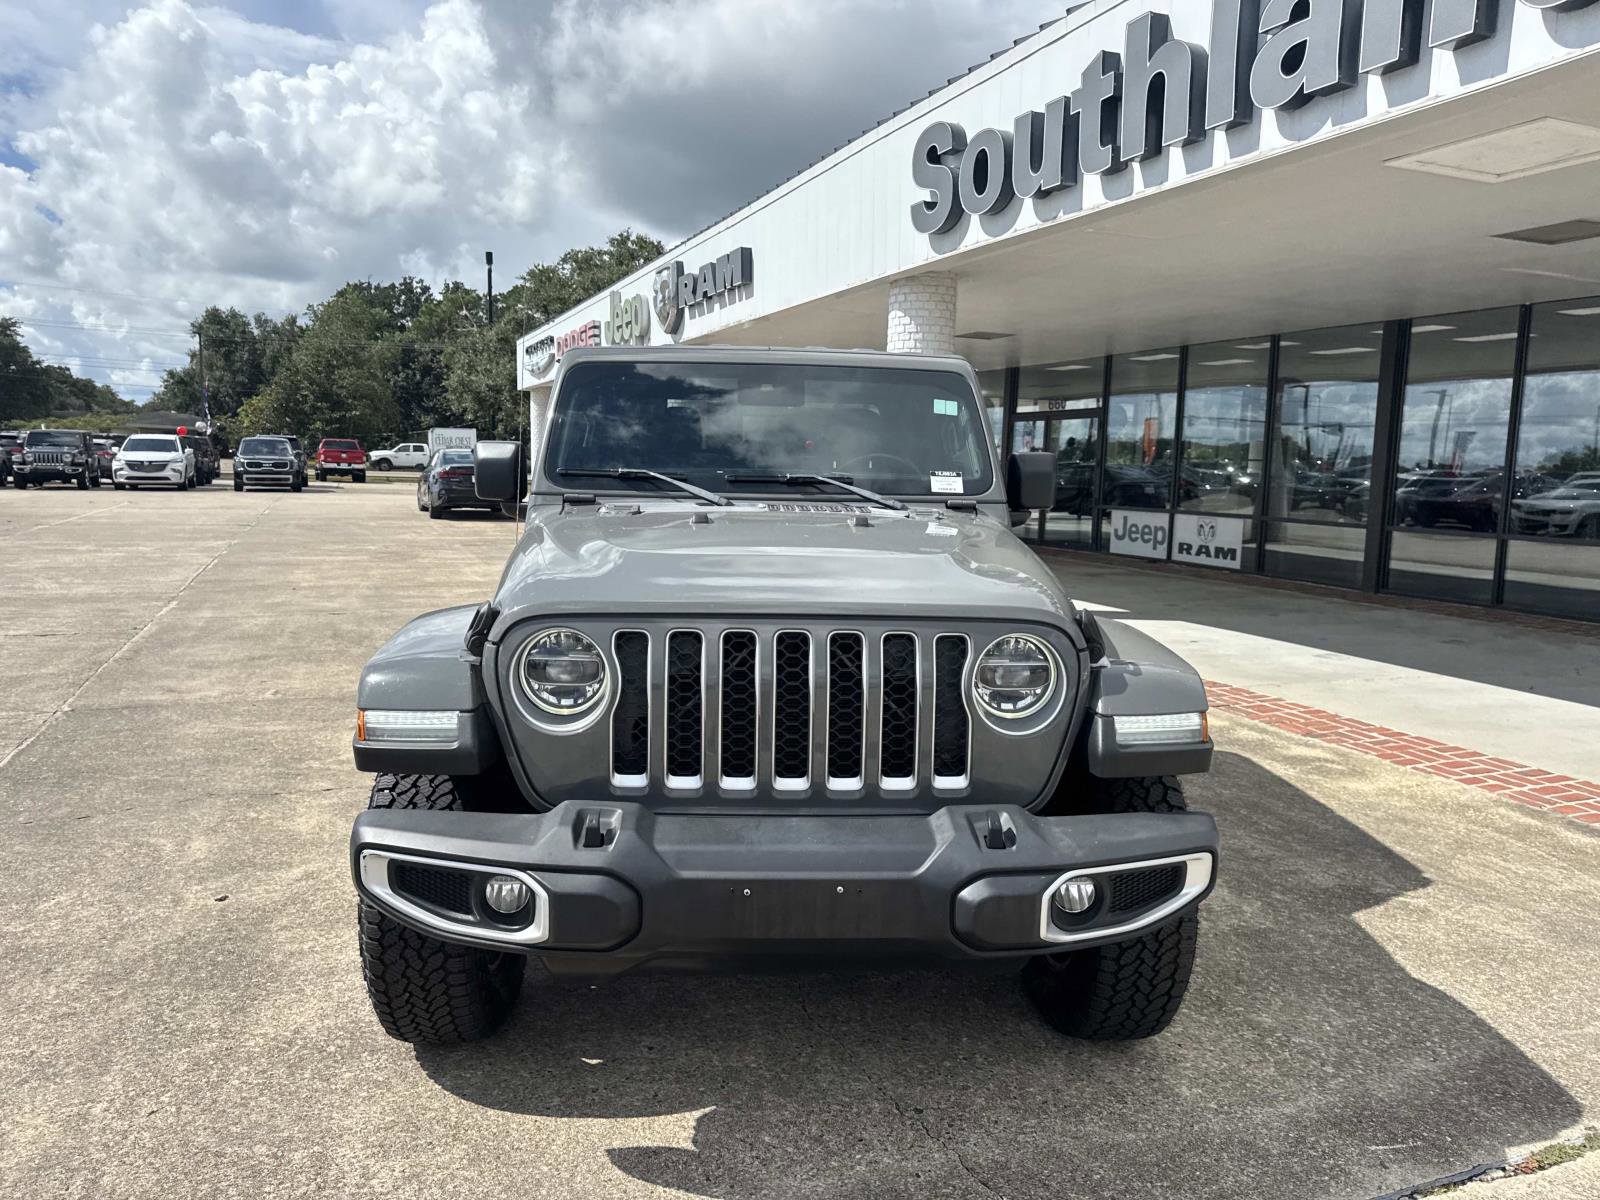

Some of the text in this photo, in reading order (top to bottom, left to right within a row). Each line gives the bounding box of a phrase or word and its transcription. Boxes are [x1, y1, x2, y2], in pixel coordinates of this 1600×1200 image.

[910, 0, 1598, 235] Southla
[679, 246, 752, 308] RAM
[556, 320, 600, 358] DODGE
[604, 290, 649, 345] Jeep
[1114, 515, 1167, 550] Jeep
[1178, 542, 1237, 561] RAM
